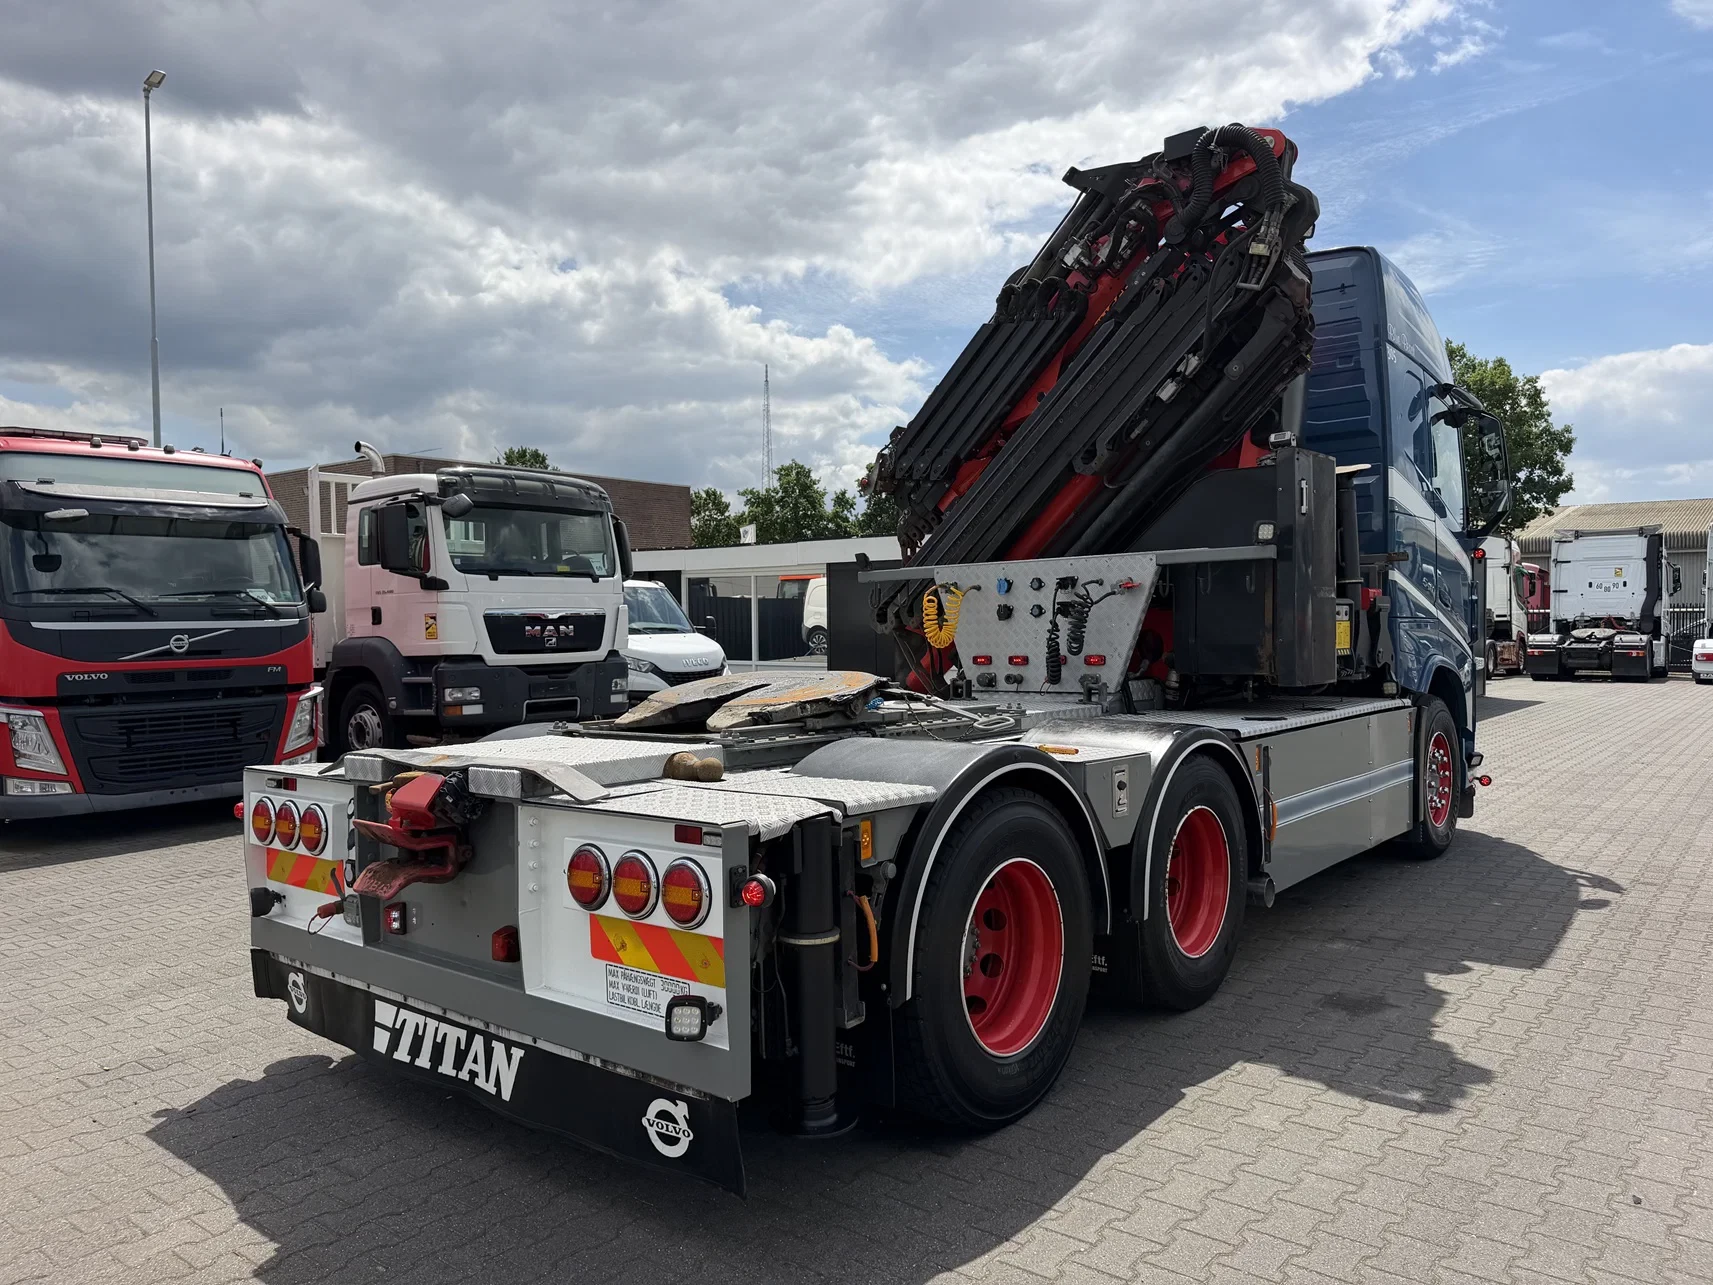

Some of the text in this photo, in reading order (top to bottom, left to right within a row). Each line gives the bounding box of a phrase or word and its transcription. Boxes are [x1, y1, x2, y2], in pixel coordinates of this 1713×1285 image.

[1595, 582, 1603, 590] 60
[1611, 582, 1620, 590] 90
[524, 625, 575, 638] MAN
[681, 657, 709, 668] IVECO
[64, 673, 109, 681] VOLVO
[608, 968, 619, 980] MAX
[608, 979, 619, 991] MAX
[393, 1008, 525, 1102] TITAN
[645, 1117, 691, 1138] VOLVO
